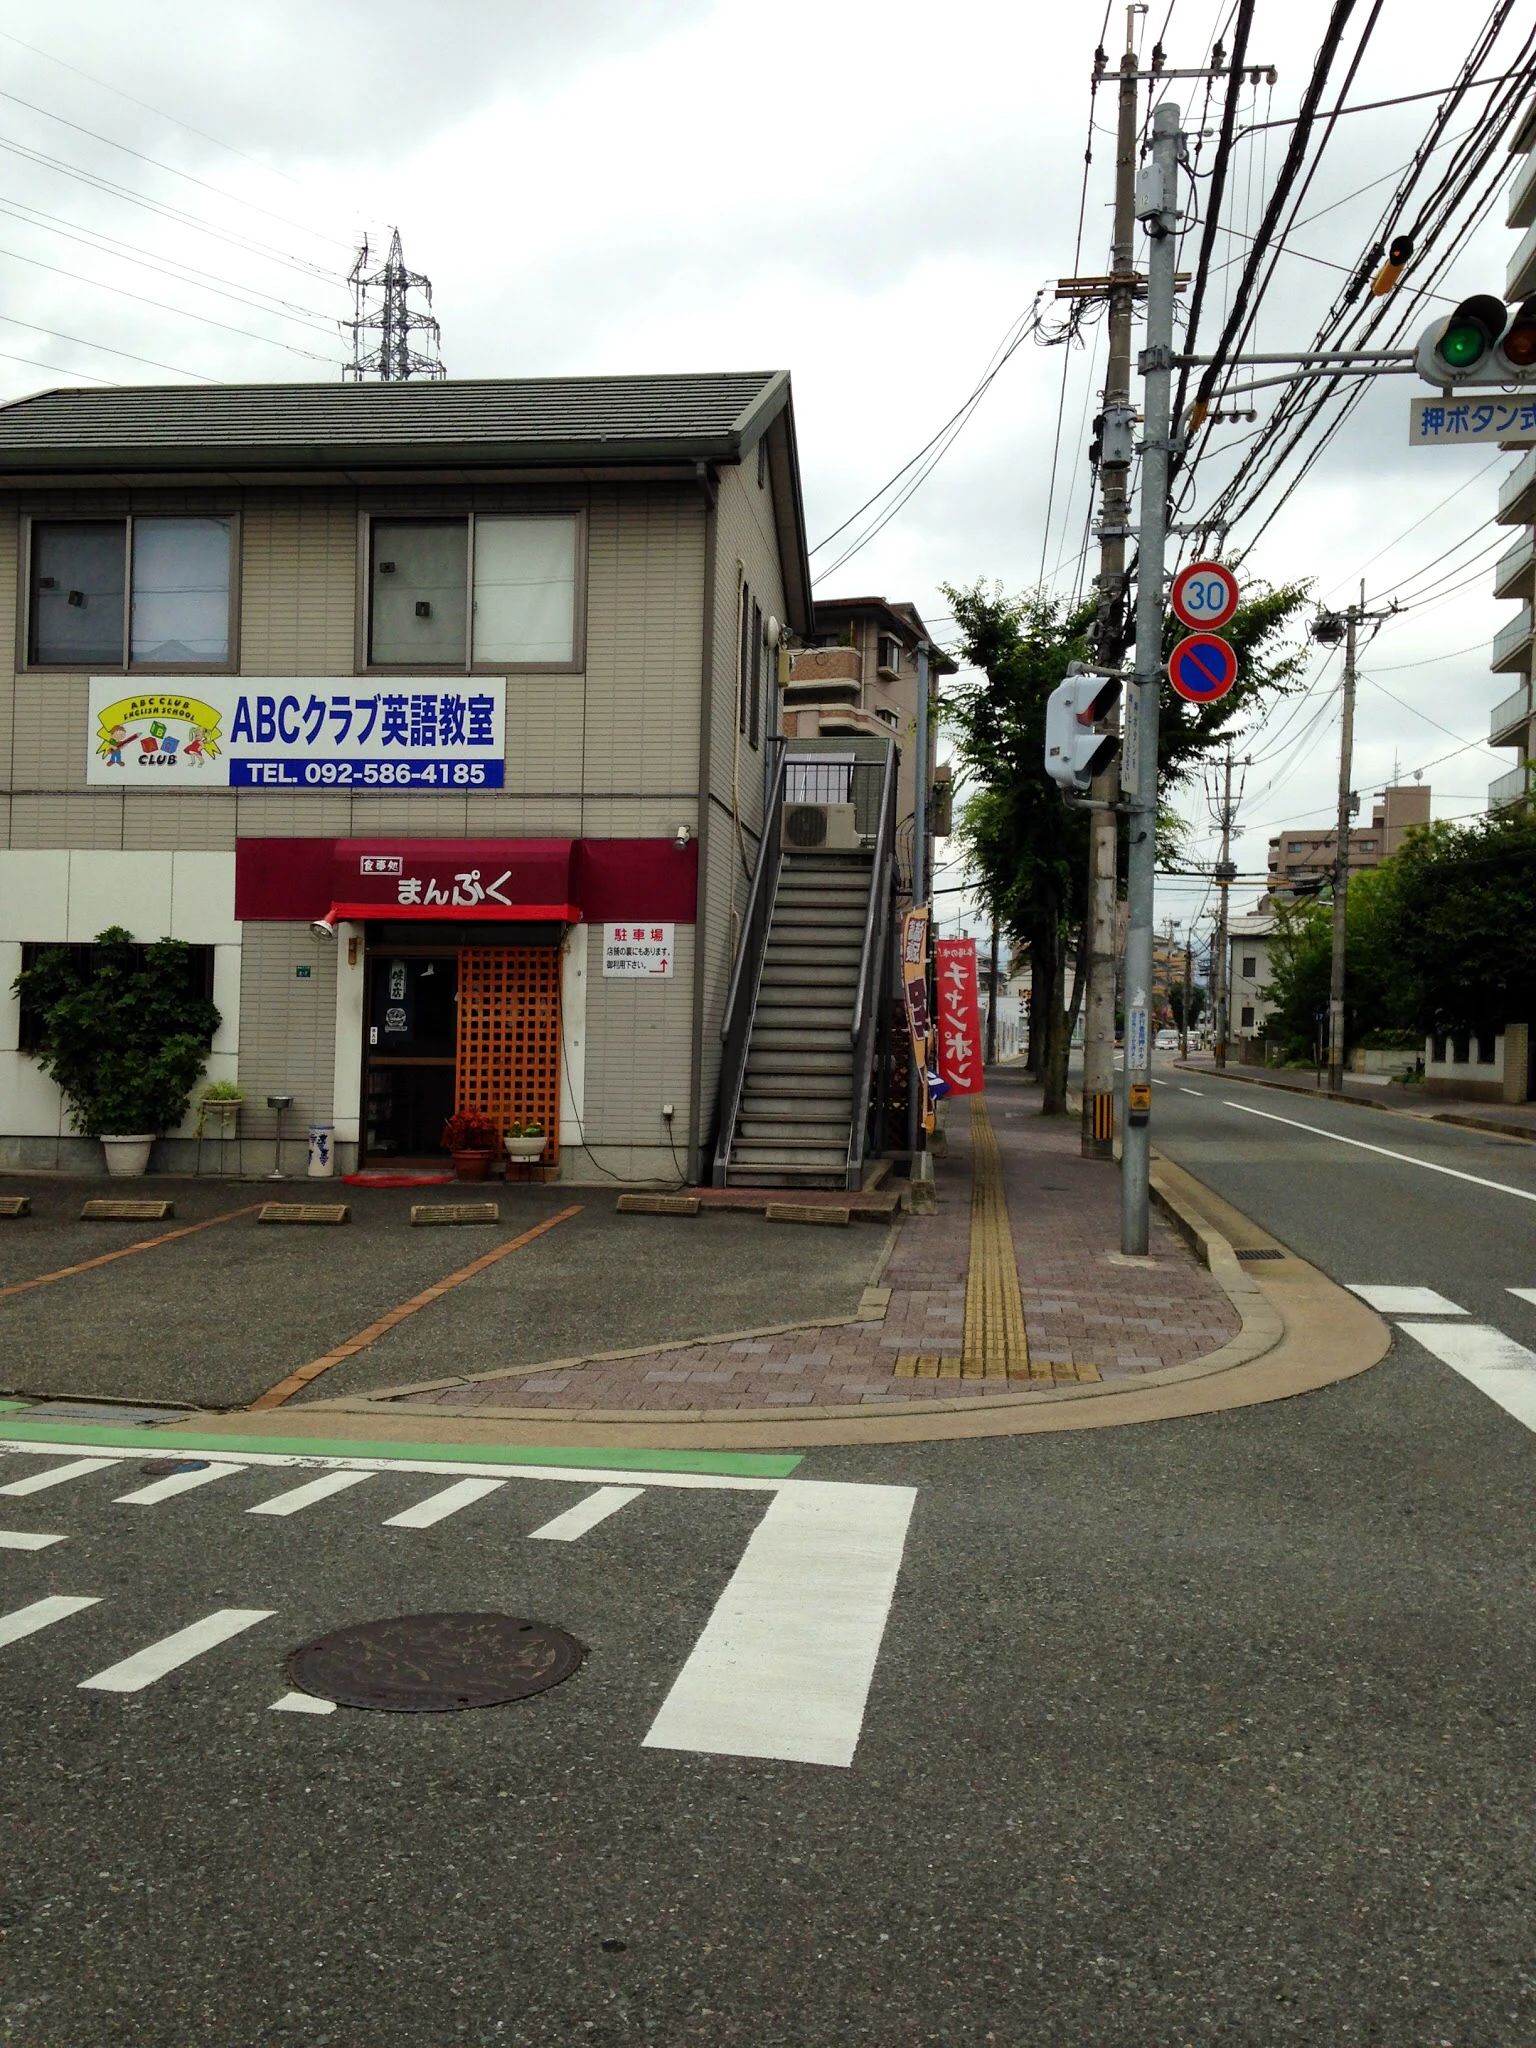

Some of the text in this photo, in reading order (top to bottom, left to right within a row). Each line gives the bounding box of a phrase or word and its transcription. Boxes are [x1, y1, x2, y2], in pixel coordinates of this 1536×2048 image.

[1188, 581, 1224, 611] 30
[131, 697, 190, 710] ABC CLUB
[123, 707, 196, 721] ENGLISH SCHOOL
[230, 693, 495, 747] ABCクラブ英語教室
[138, 754, 177, 766] CLUB
[247, 763, 485, 784] TEL. 092-586-4185
[363, 859, 400, 872] 食事処
[397, 869, 513, 907] まんぷく
[614, 928, 664, 942] 駐車場
